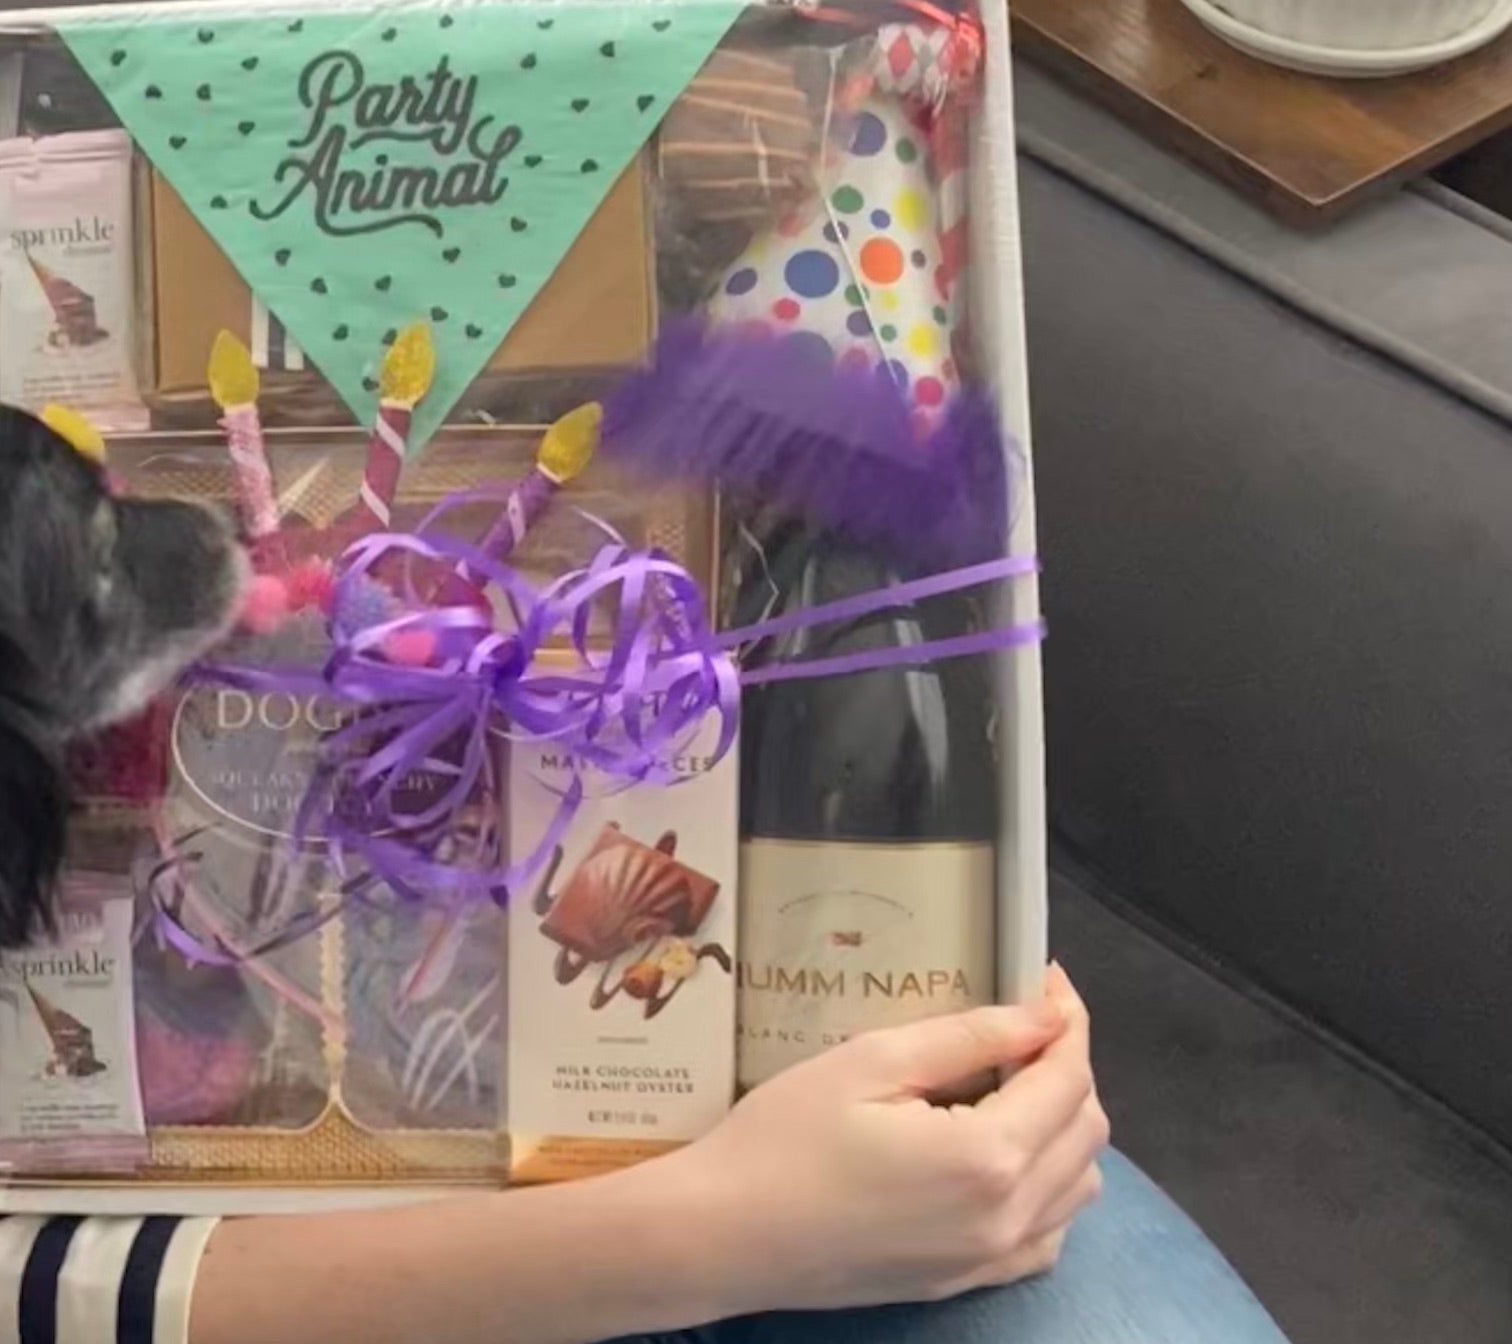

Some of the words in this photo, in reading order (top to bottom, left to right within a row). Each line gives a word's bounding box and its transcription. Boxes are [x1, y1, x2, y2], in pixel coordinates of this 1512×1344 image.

[288, 50, 478, 155] Party
[249, 112, 524, 238] Animal
[10, 216, 116, 250] sprinkle
[10, 949, 116, 982] sprinkle
[861, 968, 972, 999] NAPA
[552, 1079, 631, 1093] HAZELNUT
[555, 1064, 591, 1077] MILK
[595, 1065, 691, 1080] CHOCOLATE
